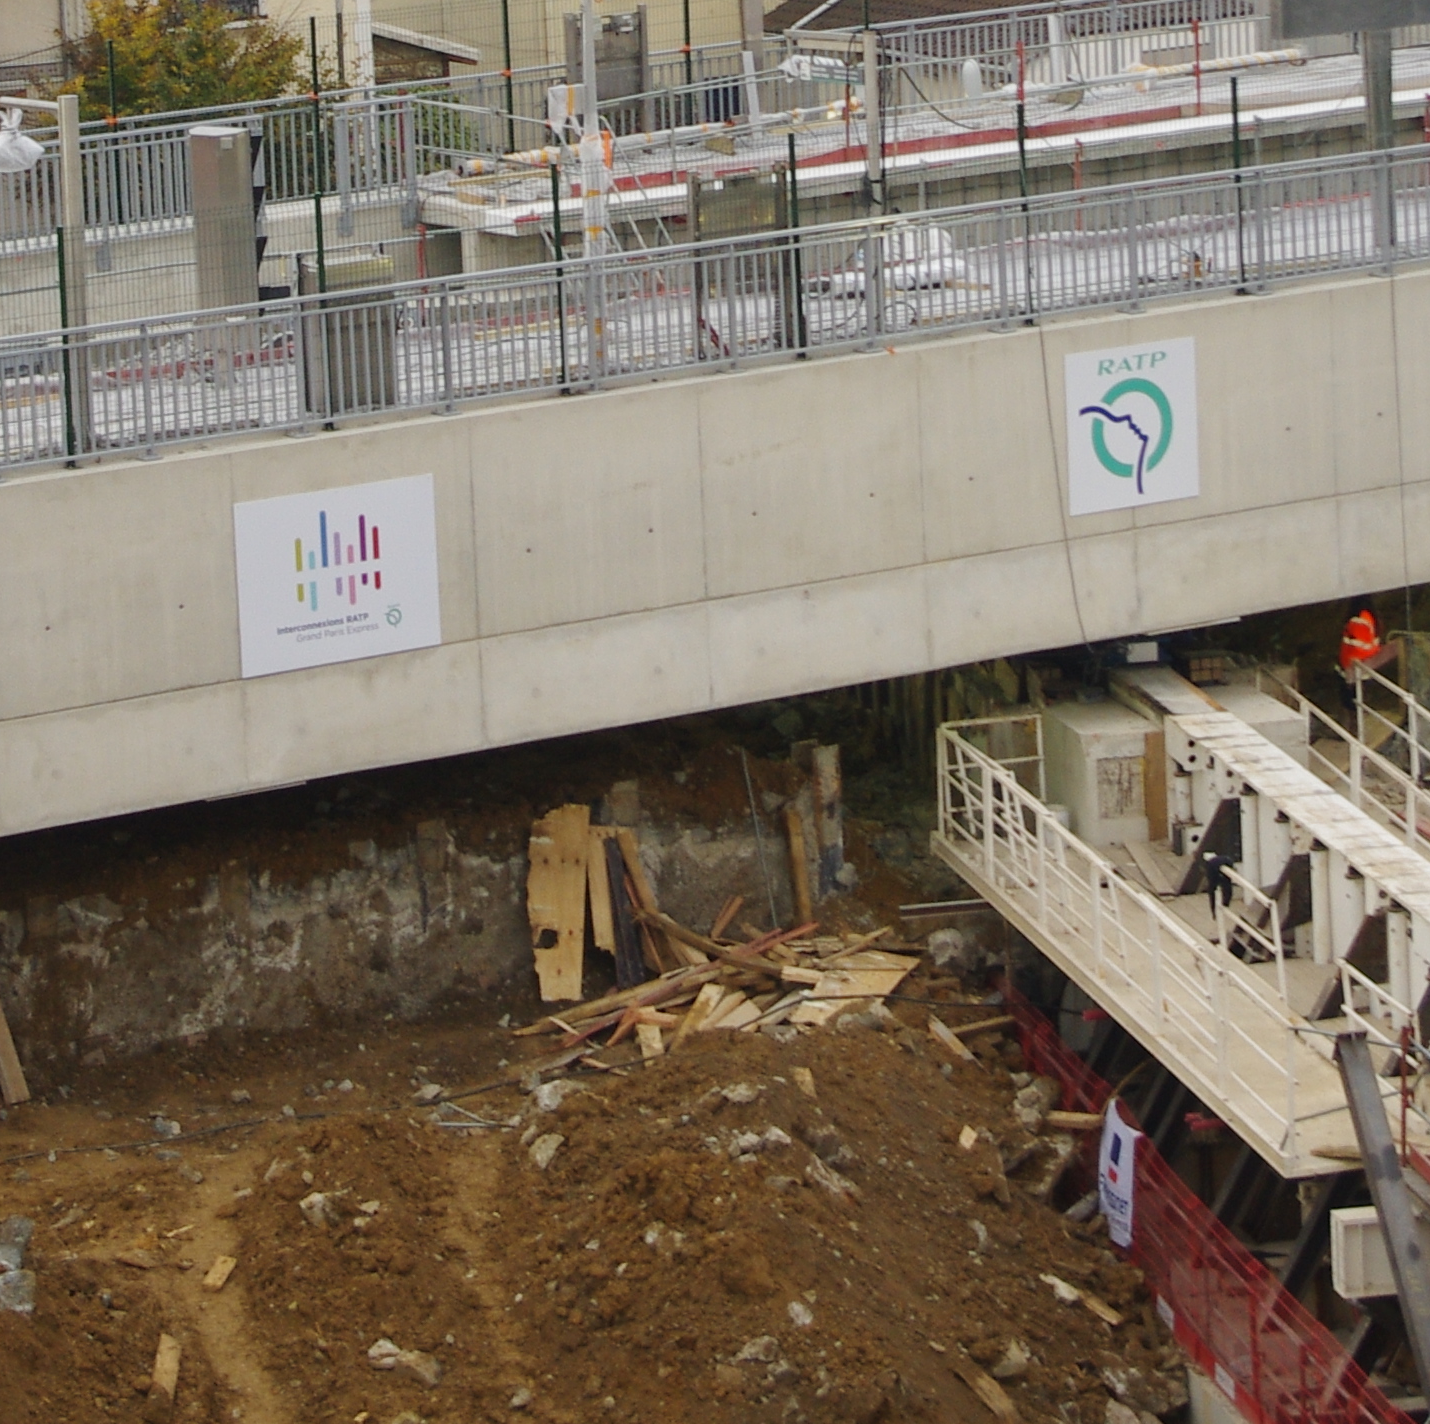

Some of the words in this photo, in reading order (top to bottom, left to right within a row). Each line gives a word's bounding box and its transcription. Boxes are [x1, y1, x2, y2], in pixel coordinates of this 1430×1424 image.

[1097, 351, 1168, 376] RATP
[277, 617, 344, 635] Interconnexions
[346, 612, 369, 624] RATP
[296, 630, 322, 643] Grand
[324, 627, 345, 638] Paris
[346, 622, 379, 637] Express
